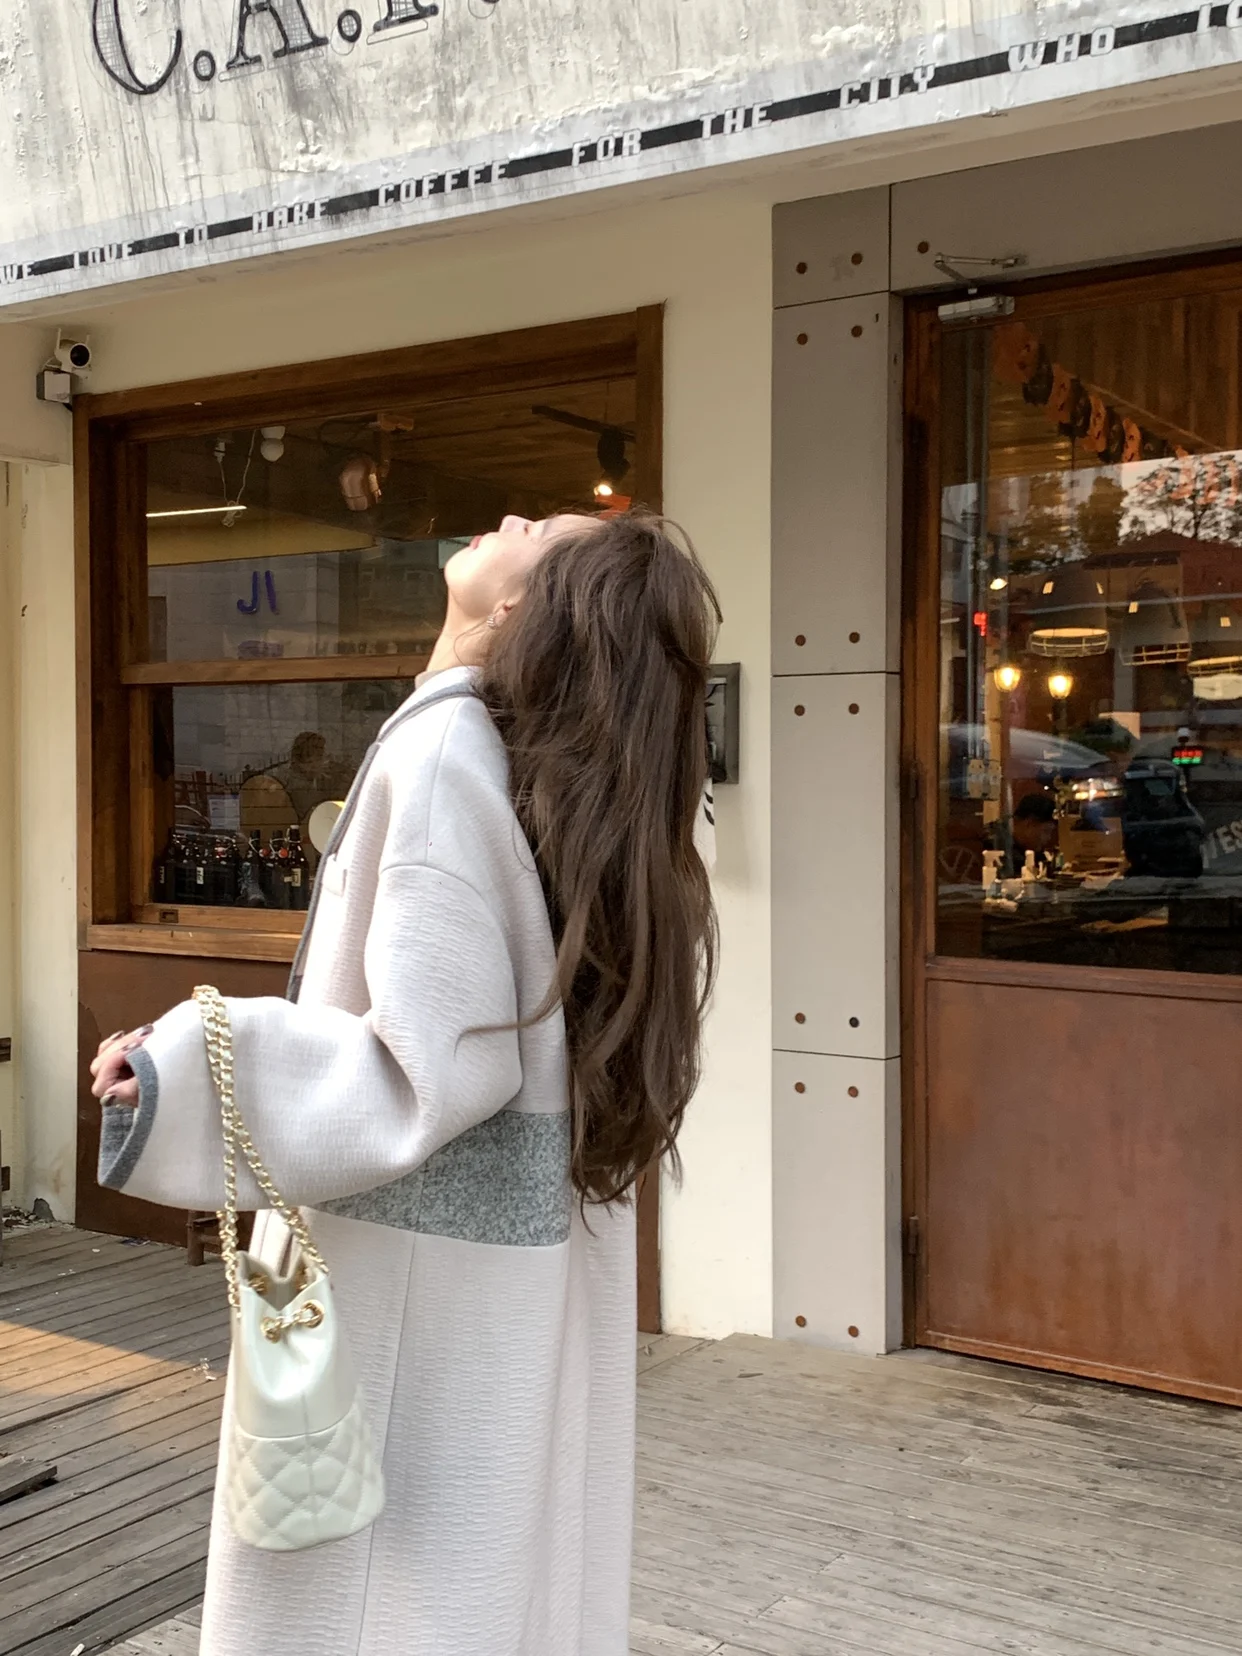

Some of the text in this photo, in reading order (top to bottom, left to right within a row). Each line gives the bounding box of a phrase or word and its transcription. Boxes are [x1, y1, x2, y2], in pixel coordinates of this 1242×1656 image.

[0, 260, 35, 285] WE
[72, 239, 135, 271] LOVE
[174, 223, 209, 250] TO
[251, 196, 330, 235] MAKE
[377, 158, 510, 208] COFFEE
[570, 127, 643, 167] FOR
[700, 100, 774, 140] THE
[839, 63, 936, 110] CITY
[1007, 25, 1116, 72] WHO
